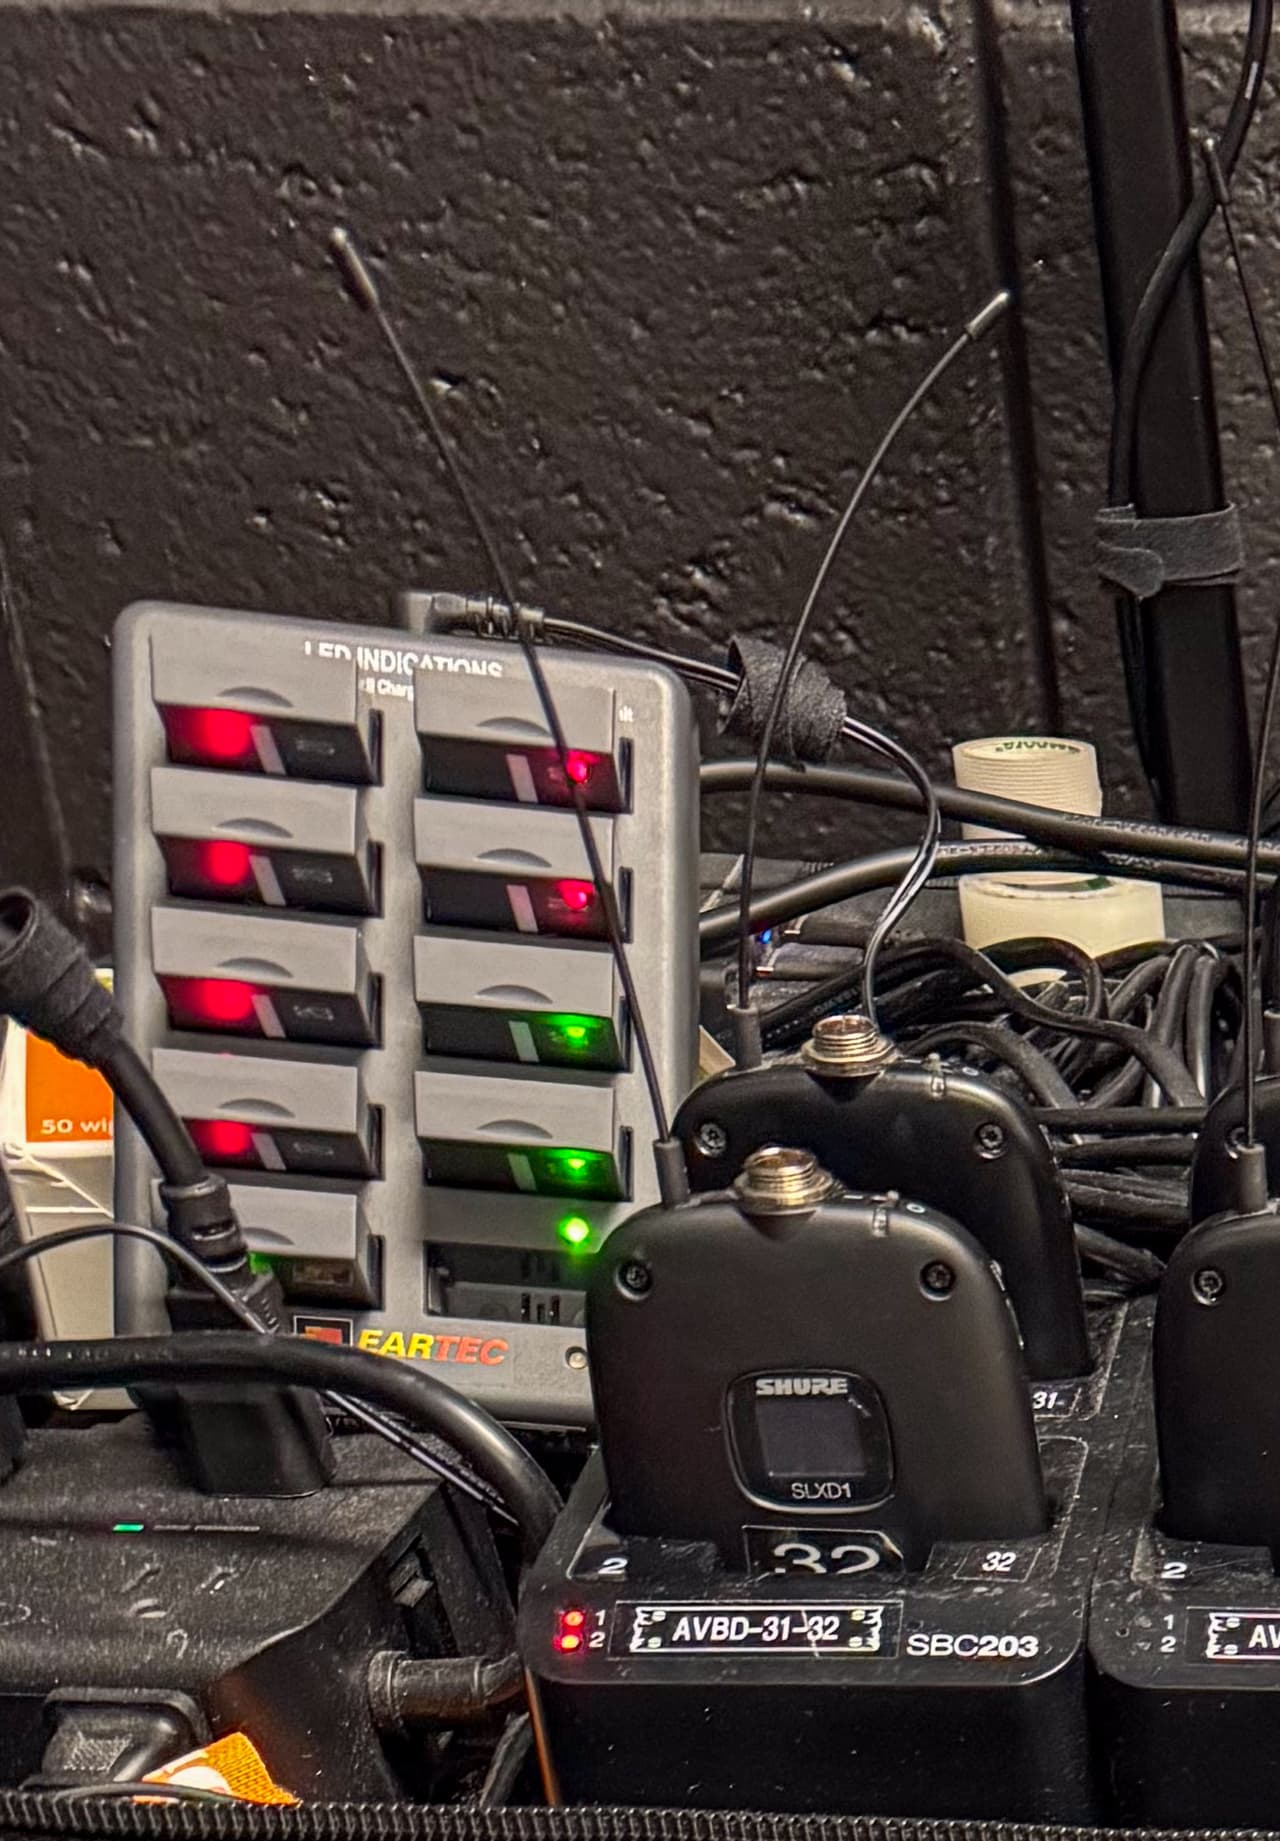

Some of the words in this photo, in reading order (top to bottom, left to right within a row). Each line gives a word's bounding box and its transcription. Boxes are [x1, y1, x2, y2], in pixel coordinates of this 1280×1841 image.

[41, 1119, 74, 1134] 50
[357, 1329, 509, 1365] EARTEC
[755, 1378, 848, 1395] SHURE
[791, 1482, 851, 1499] SLXD1
[599, 1557, 628, 1575] 2
[773, 1543, 880, 1574] 32
[981, 1551, 1017, 1572] 32
[1160, 1561, 1187, 1579] 2
[595, 1610, 606, 1626] 1
[1163, 1615, 1175, 1630] 1
[671, 1616, 840, 1642] AVBD-31-32
[589, 1631, 604, 1647] 2
[906, 1634, 1040, 1658] SBC203
[1160, 1636, 1176, 1652] 2
